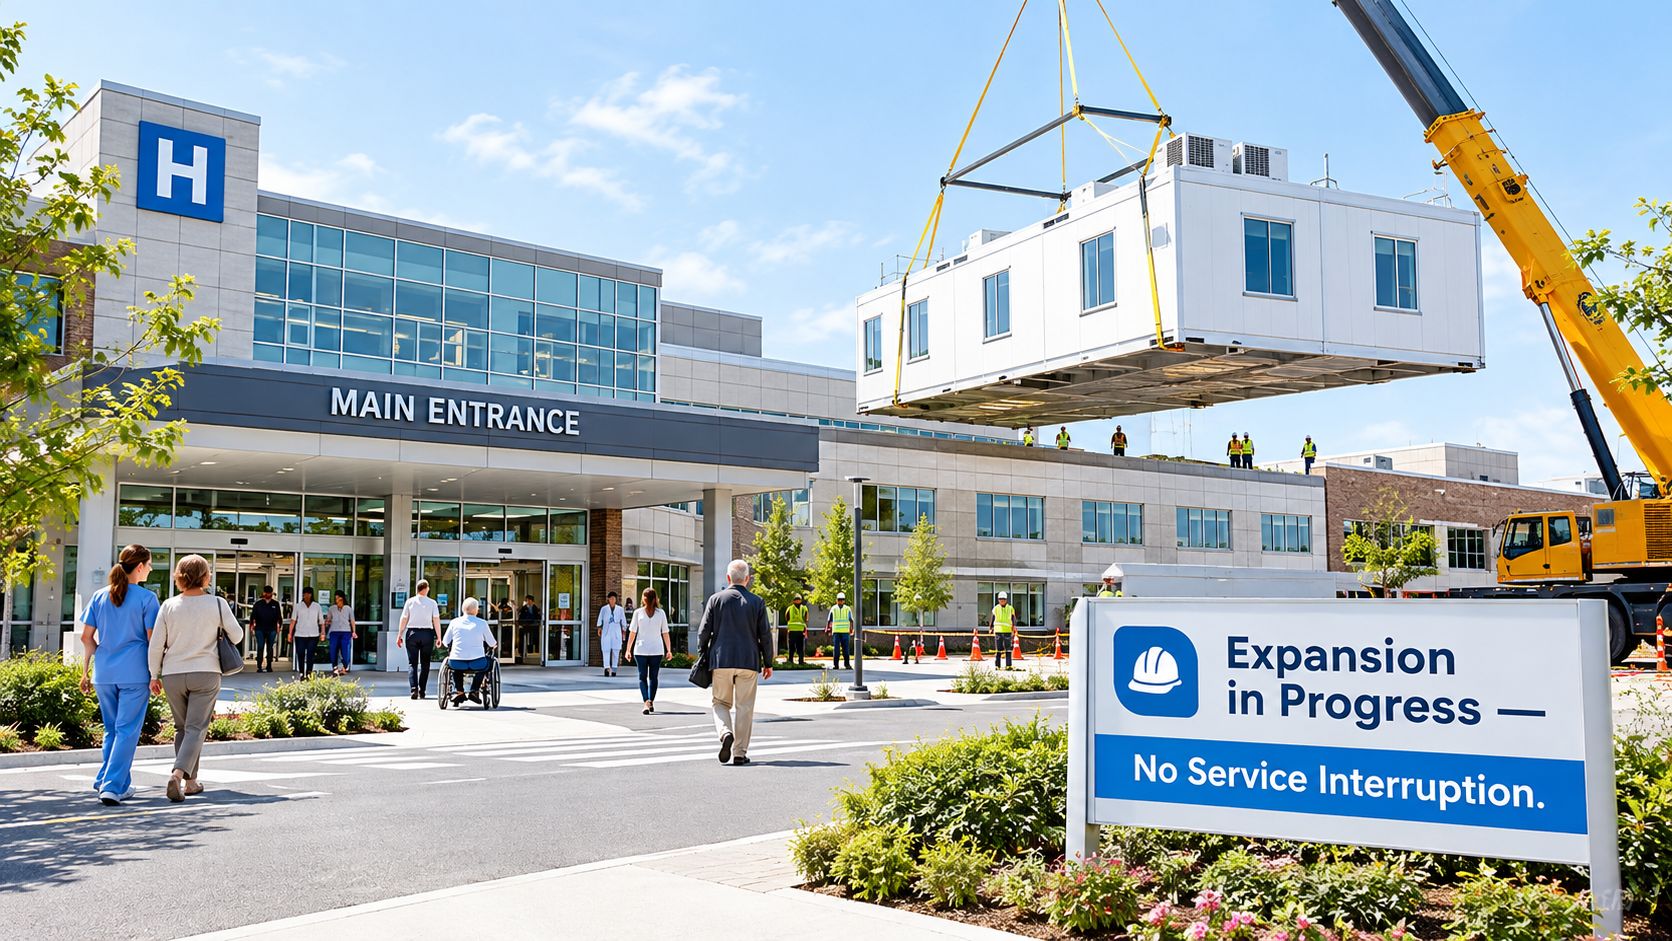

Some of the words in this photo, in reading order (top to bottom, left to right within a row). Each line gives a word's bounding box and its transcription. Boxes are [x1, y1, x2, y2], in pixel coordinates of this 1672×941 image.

[156, 137, 208, 206] H
[331, 387, 415, 422] MAIN
[428, 396, 580, 436] ENTRANCE
[1227, 635, 1456, 679] Expansion
[1228, 679, 1264, 716] in
[1280, 683, 1482, 731] Progress
[1134, 753, 1178, 784] No
[1187, 756, 1308, 793] Service
[1319, 764, 1545, 811] Interruption.
